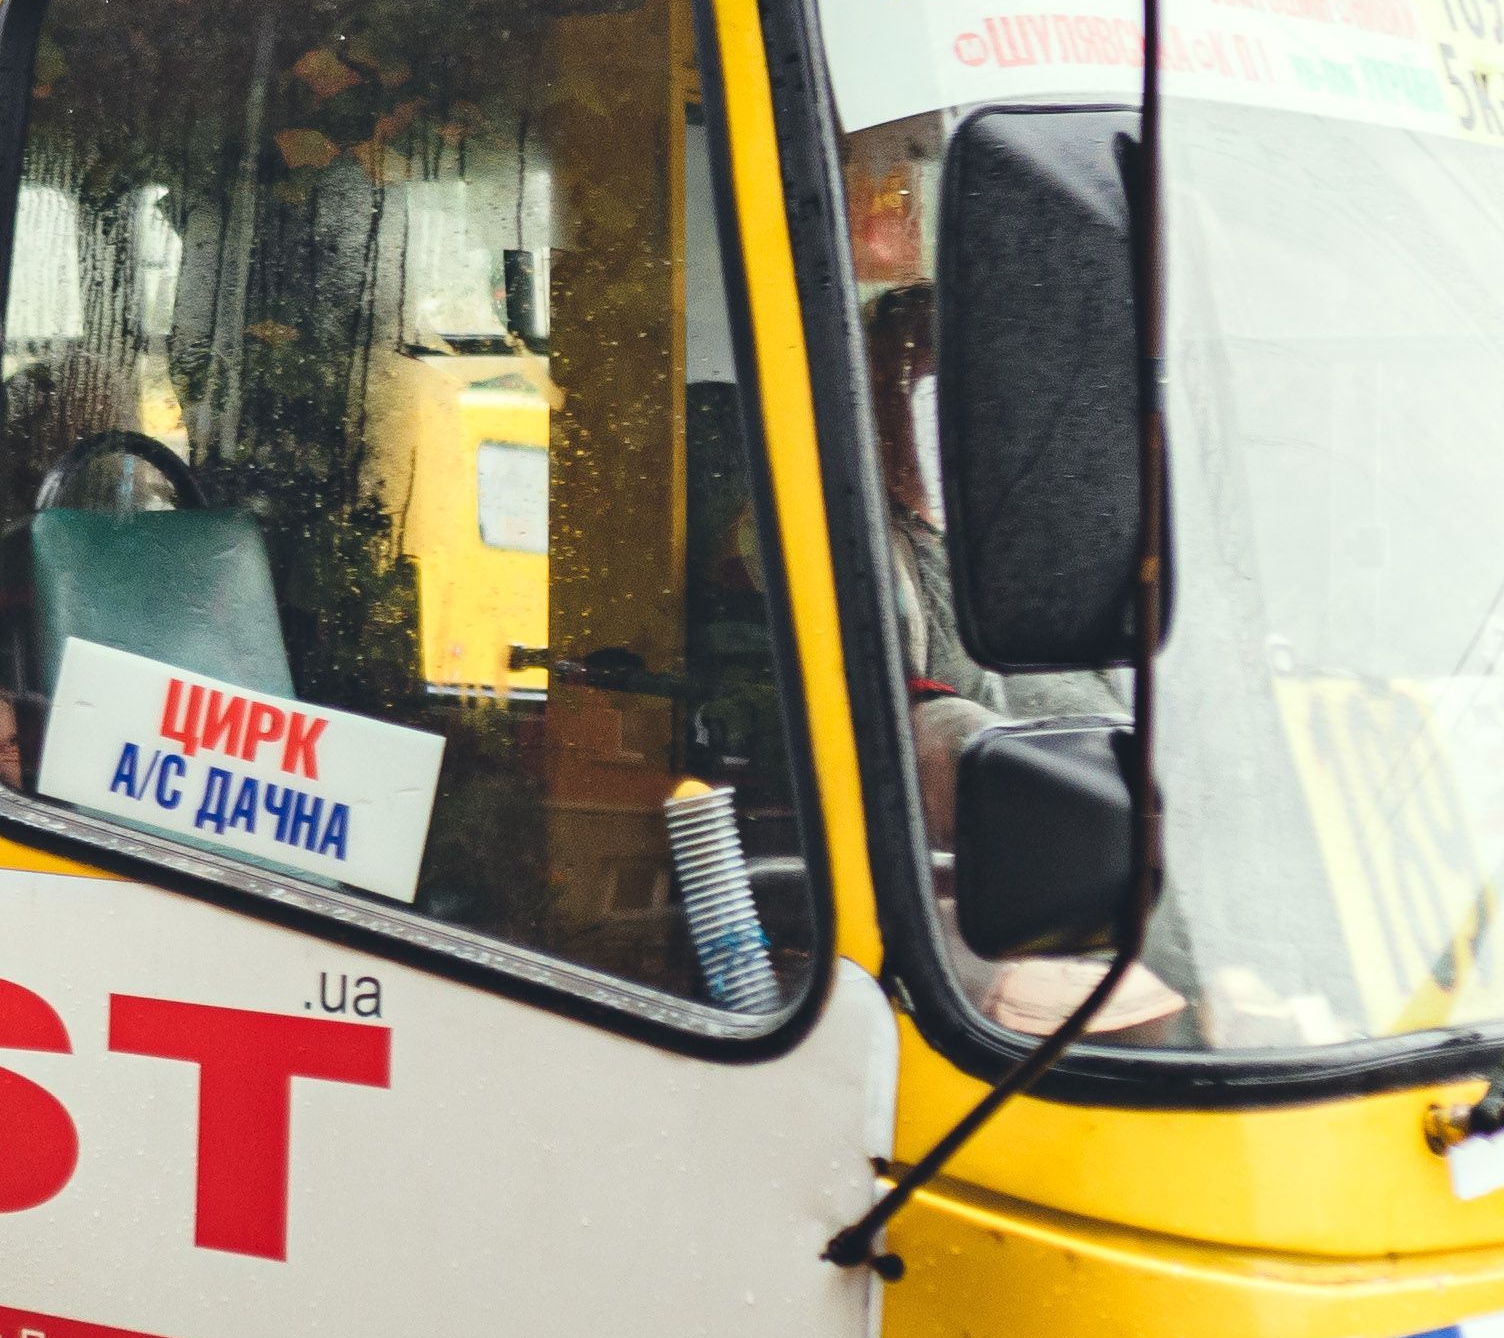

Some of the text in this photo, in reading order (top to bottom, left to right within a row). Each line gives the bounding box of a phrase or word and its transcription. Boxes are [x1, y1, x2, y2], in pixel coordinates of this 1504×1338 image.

[160, 677, 330, 781] ЦИРК
[110, 742, 351, 861] А/С ДАЧНА
[305, 972, 384, 1018] .ua
